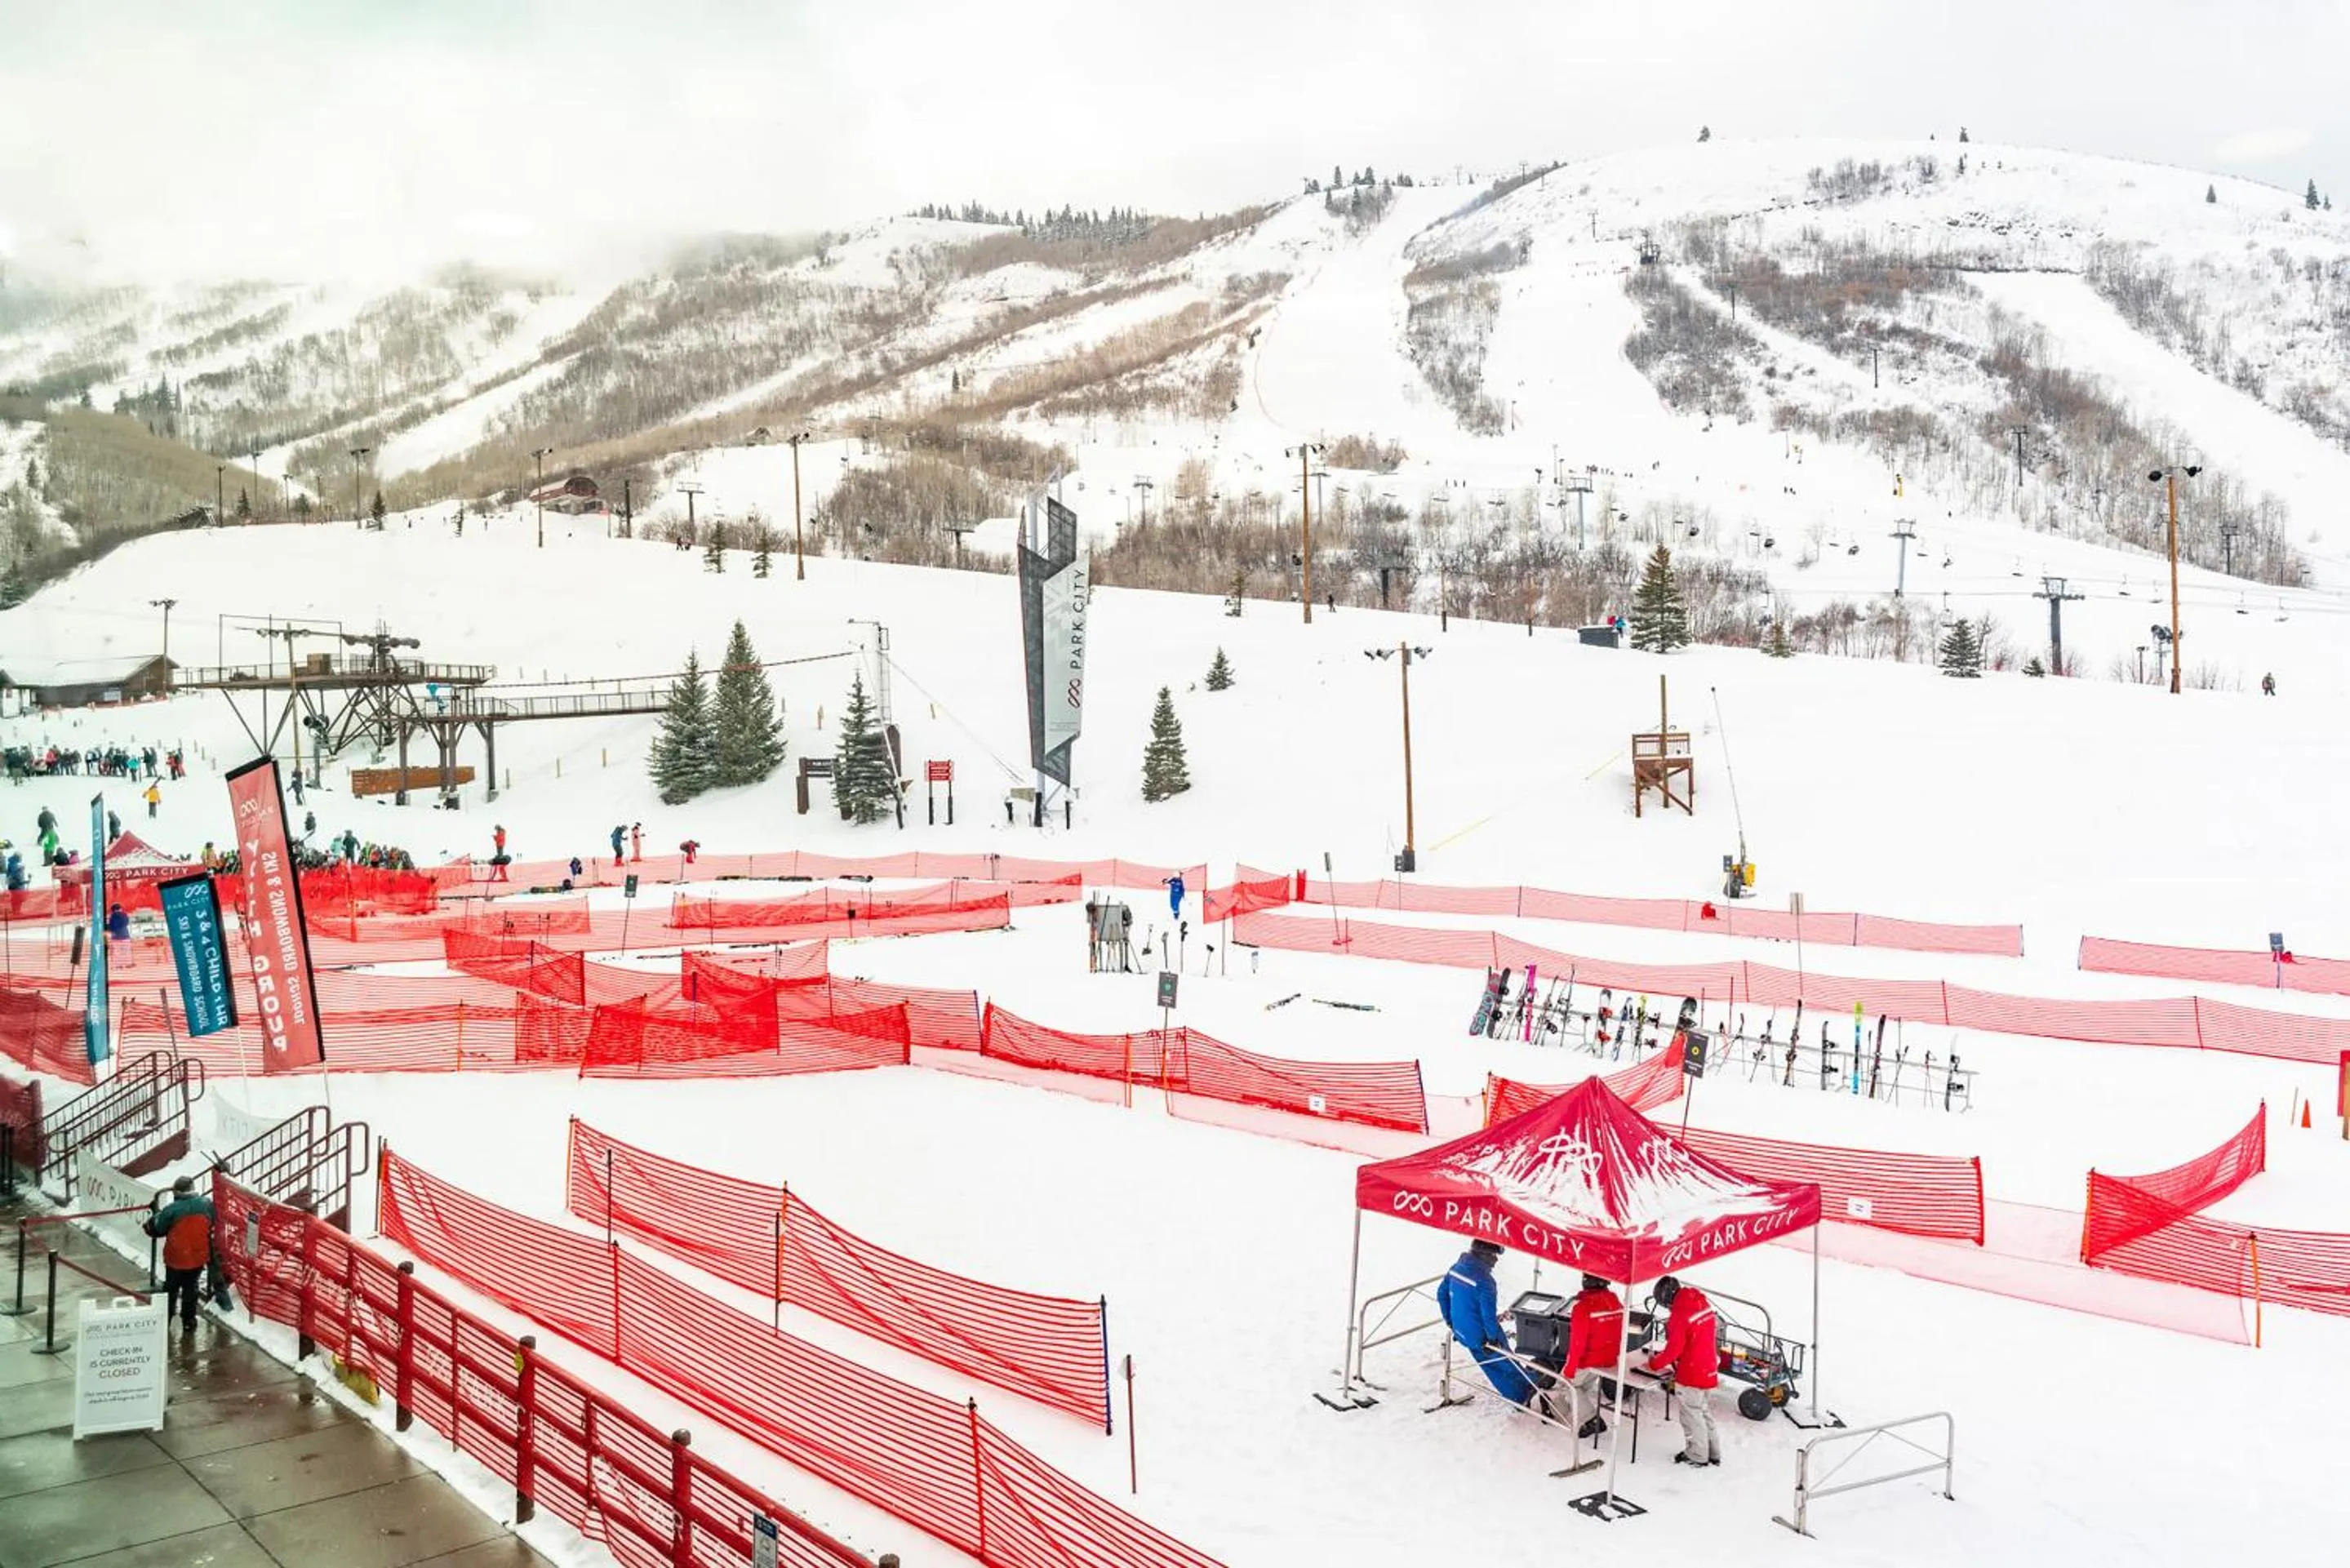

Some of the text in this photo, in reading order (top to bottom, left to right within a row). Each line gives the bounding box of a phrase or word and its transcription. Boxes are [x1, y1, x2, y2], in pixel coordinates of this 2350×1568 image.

[1070, 570, 1085, 669] PARK CITY
[126, 866, 189, 878] PARK CITY
[178, 915, 190, 931] SKI
[200, 922, 212, 932] &
[183, 940, 203, 993] SNOWBOARD
[205, 946, 222, 993] CHILD
[193, 995, 211, 1030] SCHOOL
[215, 1006, 228, 1026] HR
[1445, 1201, 1585, 1260] PARK CITY
[1700, 1206, 1799, 1255] PARK CITY
[106, 1319, 157, 1331] PARK CITY
[99, 1355, 151, 1367] CURRENTLY
[99, 1367, 140, 1379] CLOSED
